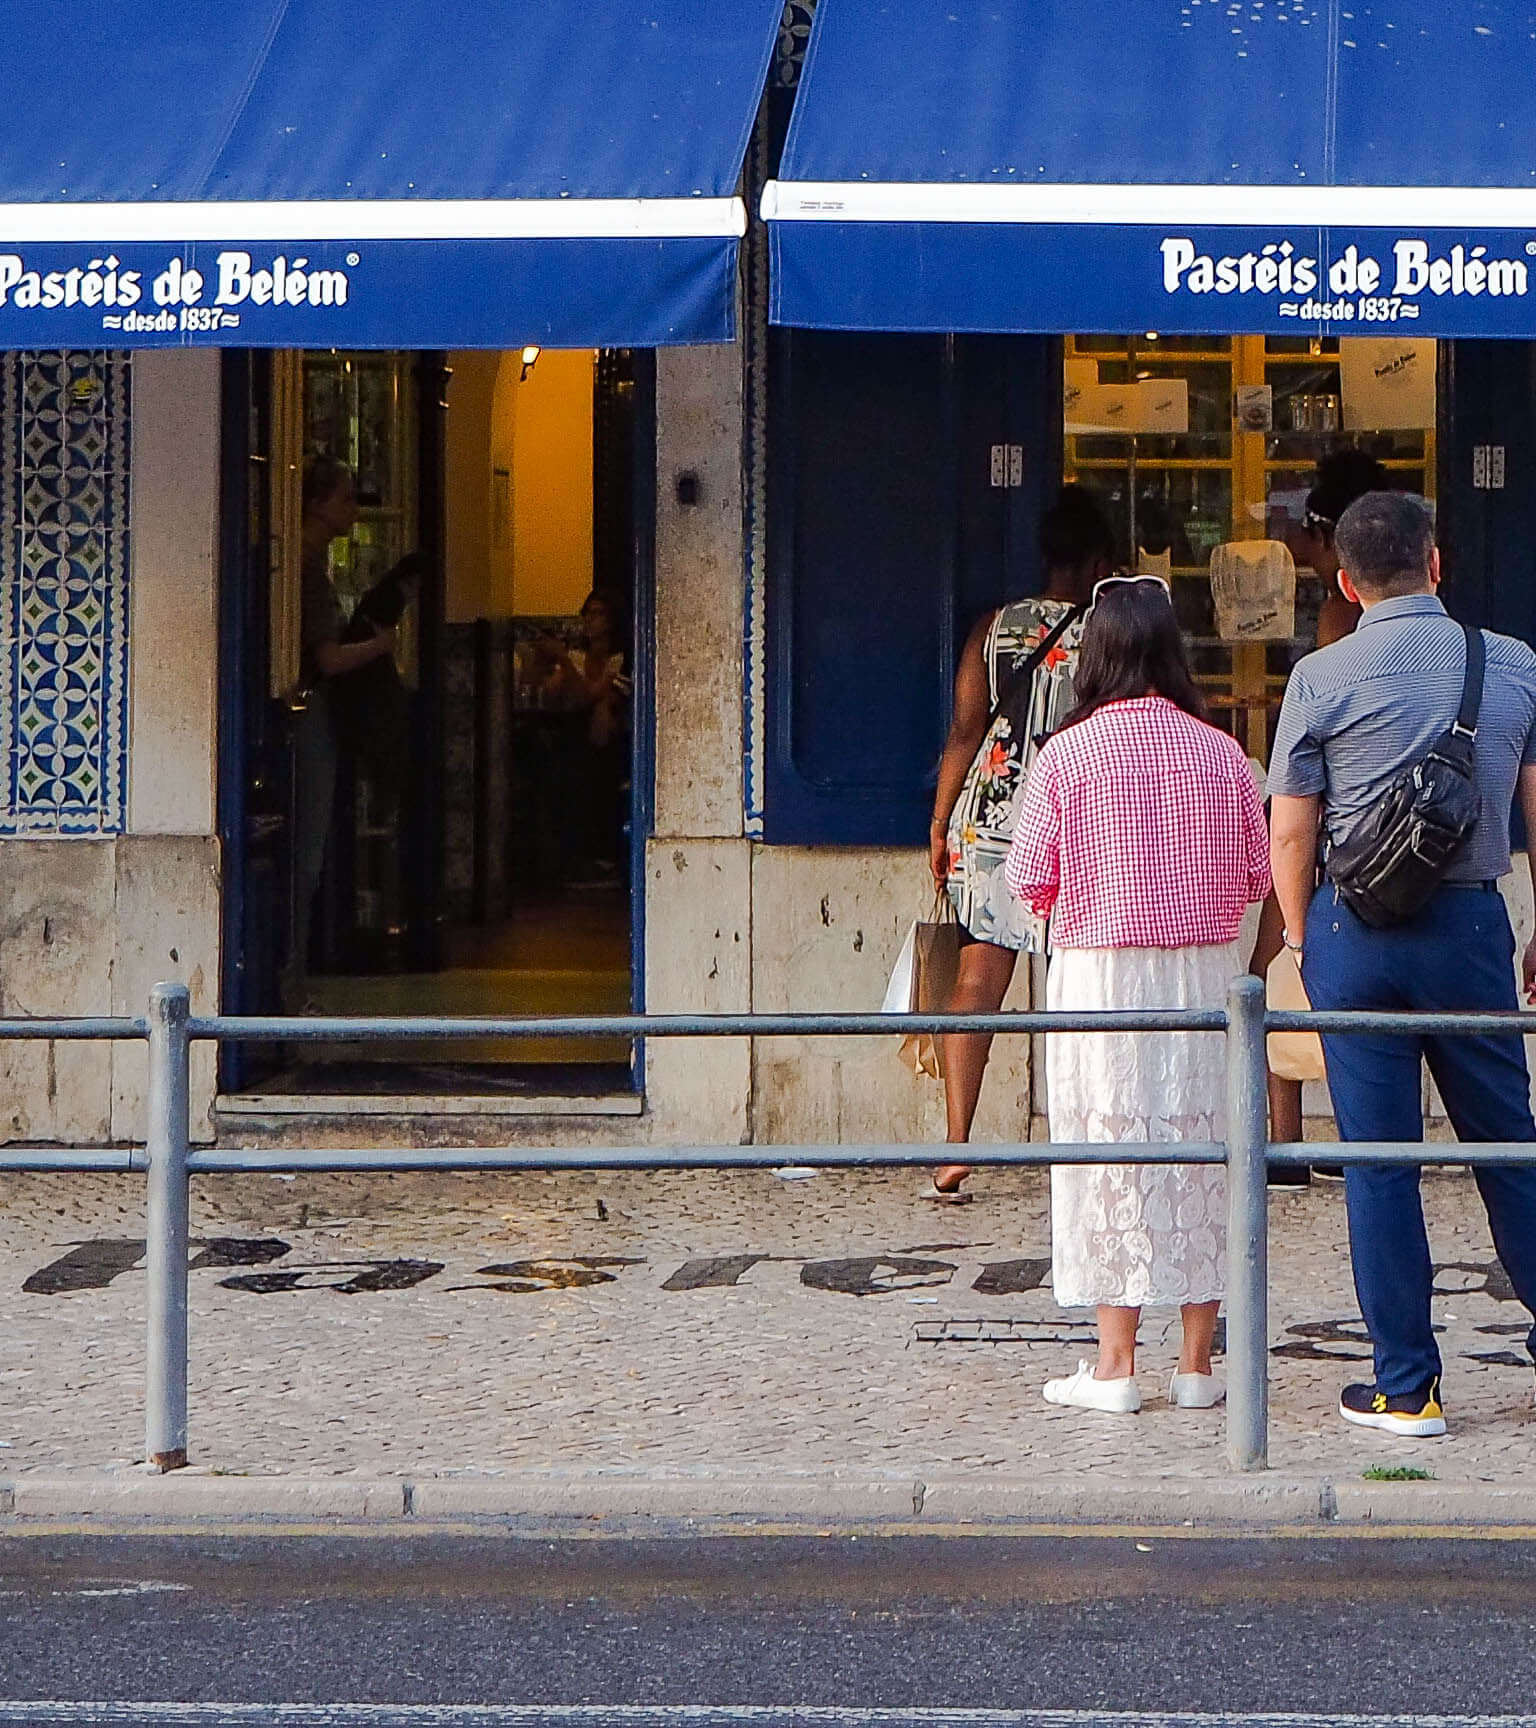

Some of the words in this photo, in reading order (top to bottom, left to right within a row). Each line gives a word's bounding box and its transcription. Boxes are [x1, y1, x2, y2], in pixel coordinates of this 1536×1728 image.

[152, 256, 204, 307] de
[1159, 237, 1317, 295] Pastéis
[1329, 244, 1380, 295] de
[179, 308, 224, 332] 1837
[1358, 297, 1402, 322] 1837
